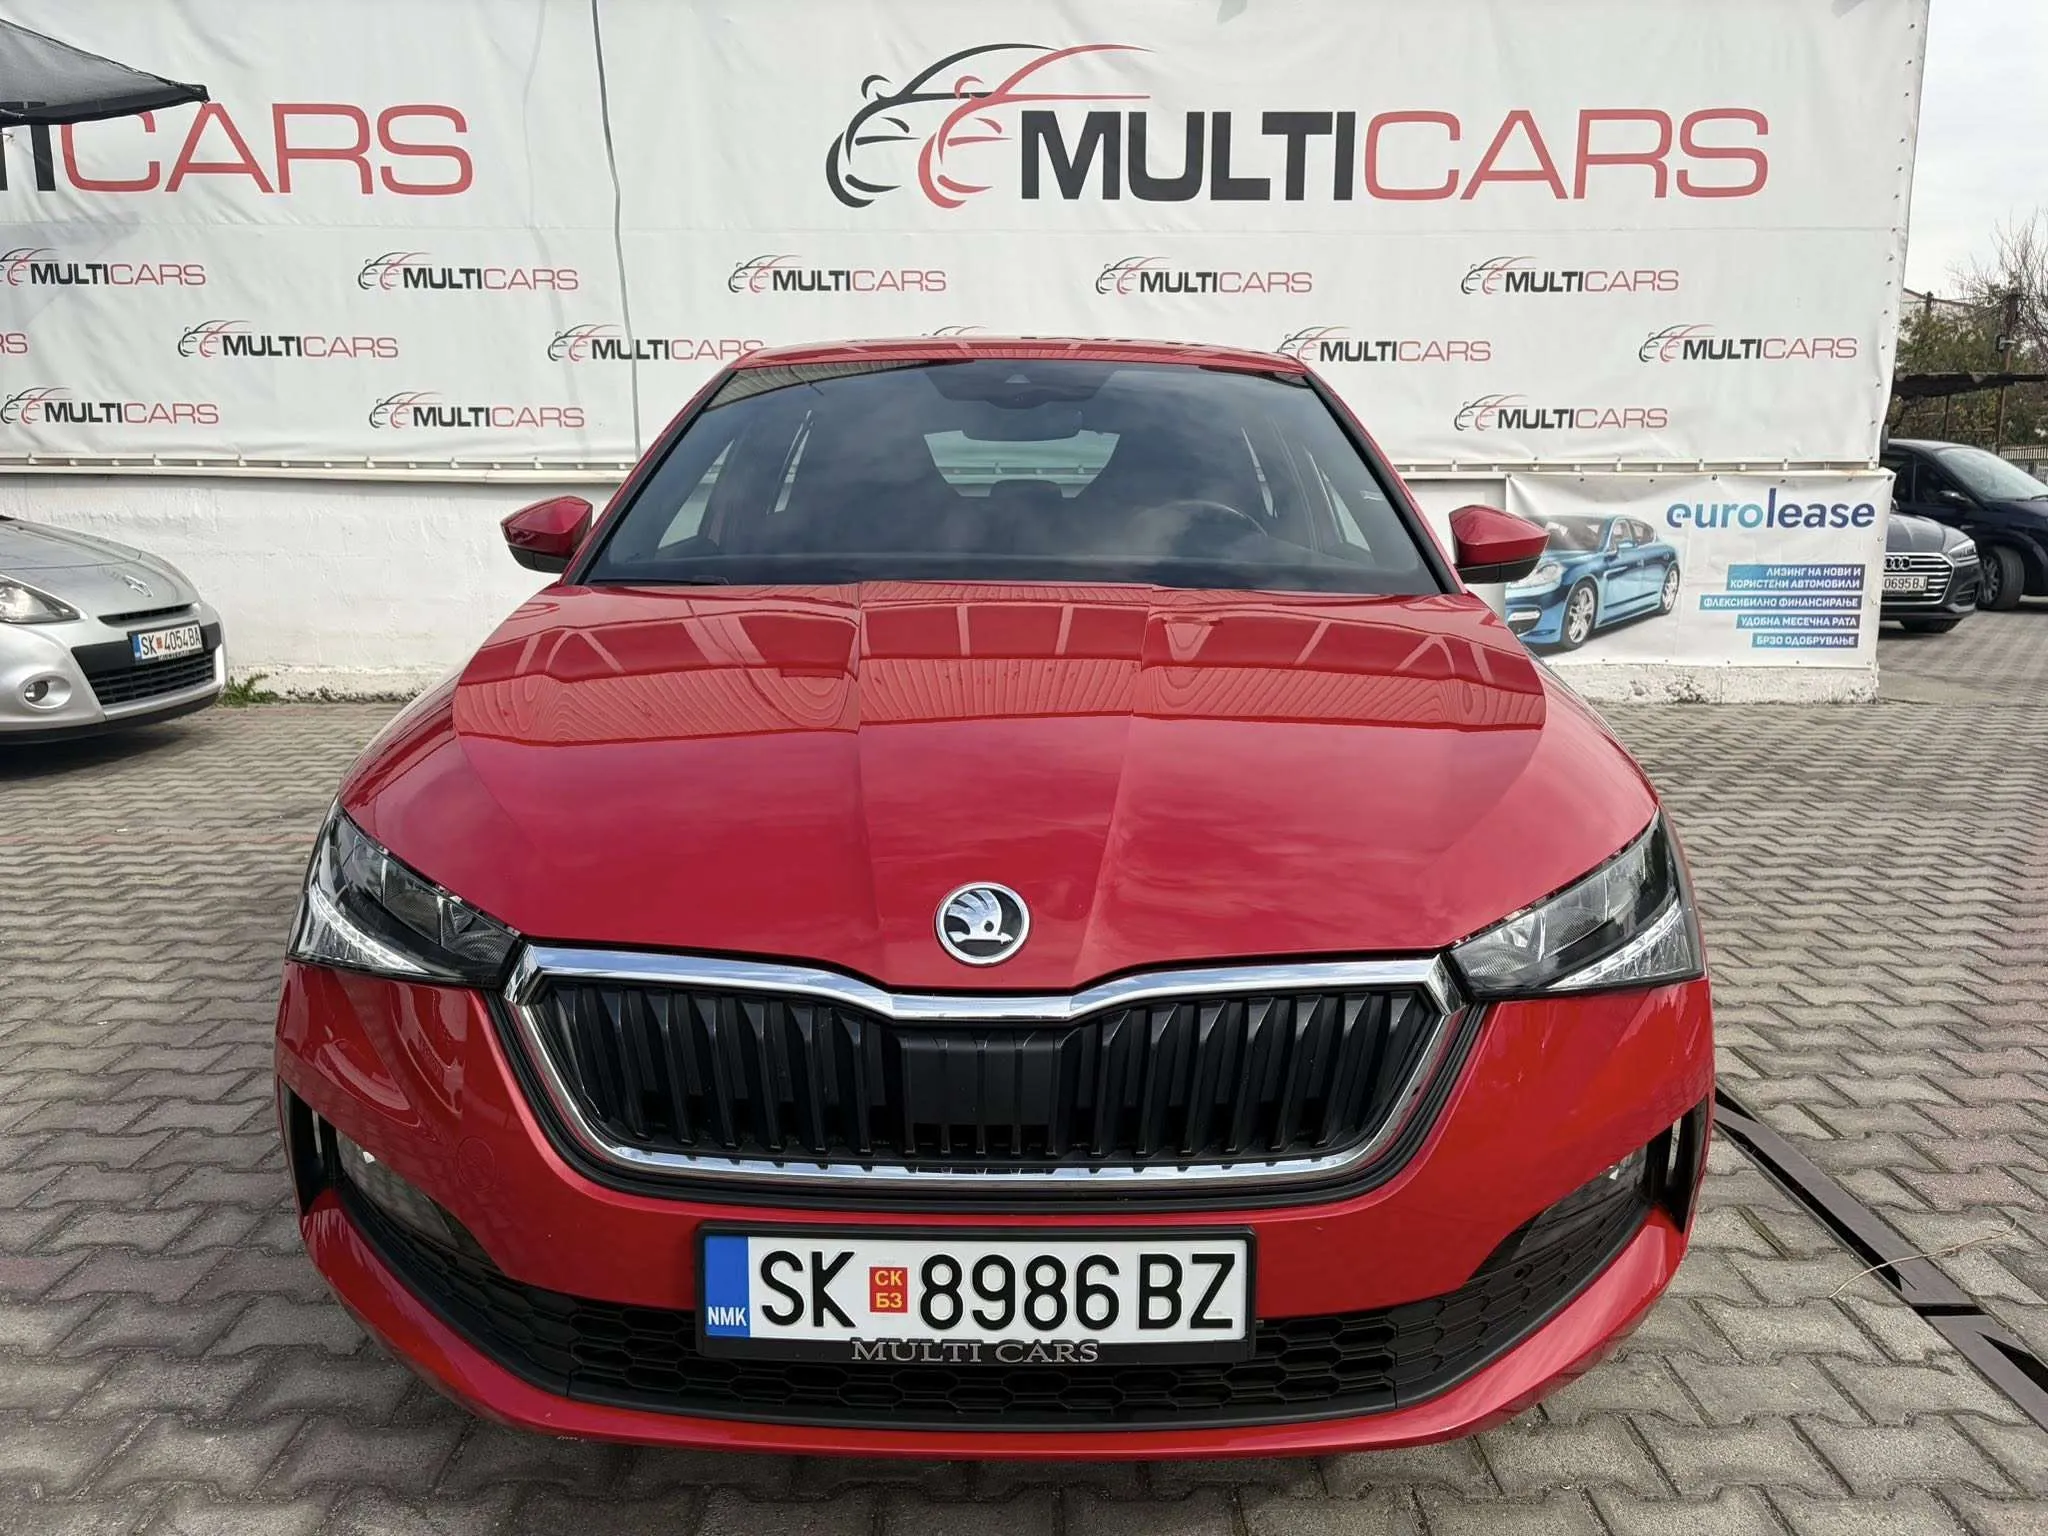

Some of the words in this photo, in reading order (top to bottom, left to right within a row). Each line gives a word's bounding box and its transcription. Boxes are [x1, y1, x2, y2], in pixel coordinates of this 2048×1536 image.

[0, 103, 473, 195] ICARS
[1021, 108, 1768, 201] MULTICARS
[31, 262, 206, 286] MULTICARS
[403, 266, 579, 291] MULTICARS
[773, 270, 947, 292] MULTICARS
[1139, 271, 1313, 294] MULTICARS
[1504, 270, 1680, 292] MULTICARS
[222, 334, 399, 359] MULTICARS
[1319, 341, 1492, 363] MULTICARS
[1682, 338, 1858, 361] MULTICARS
[44, 402, 220, 425] MULTICARS
[412, 406, 585, 429] MULTICARS
[1497, 408, 1668, 430] MULTICARS
[1666, 487, 1876, 529] eurolease
[1766, 567, 1806, 577] ЛИЗИНГ
[1807, 567, 1821, 576] НА
[1823, 567, 1852, 577] НОВИ
[1853, 567, 1861, 576] И
[1730, 579, 1789, 589] КОРИСТЕНИ
[1790, 579, 1860, 589] АВТОМОБИЛИ
[1703, 598, 1777, 608] ФЛЕКСИБИЛНО
[1778, 598, 1858, 608] ФИНАНСИРАЊЕ
[1741, 617, 1780, 627] УДОБНА
[1782, 616, 1831, 627] МЕСЕЧНА
[1832, 616, 1857, 626] РАТА
[141, 634, 158, 656] SK
[1756, 636, 1784, 646] БРЗО
[1785, 636, 1855, 646] ОДОБРУВАЊЕ
[760, 1249, 858, 1328] SK
[707, 1306, 748, 1327] NMK
[850, 1340, 982, 1363] MULTI
[994, 1342, 1100, 1364] CARS
